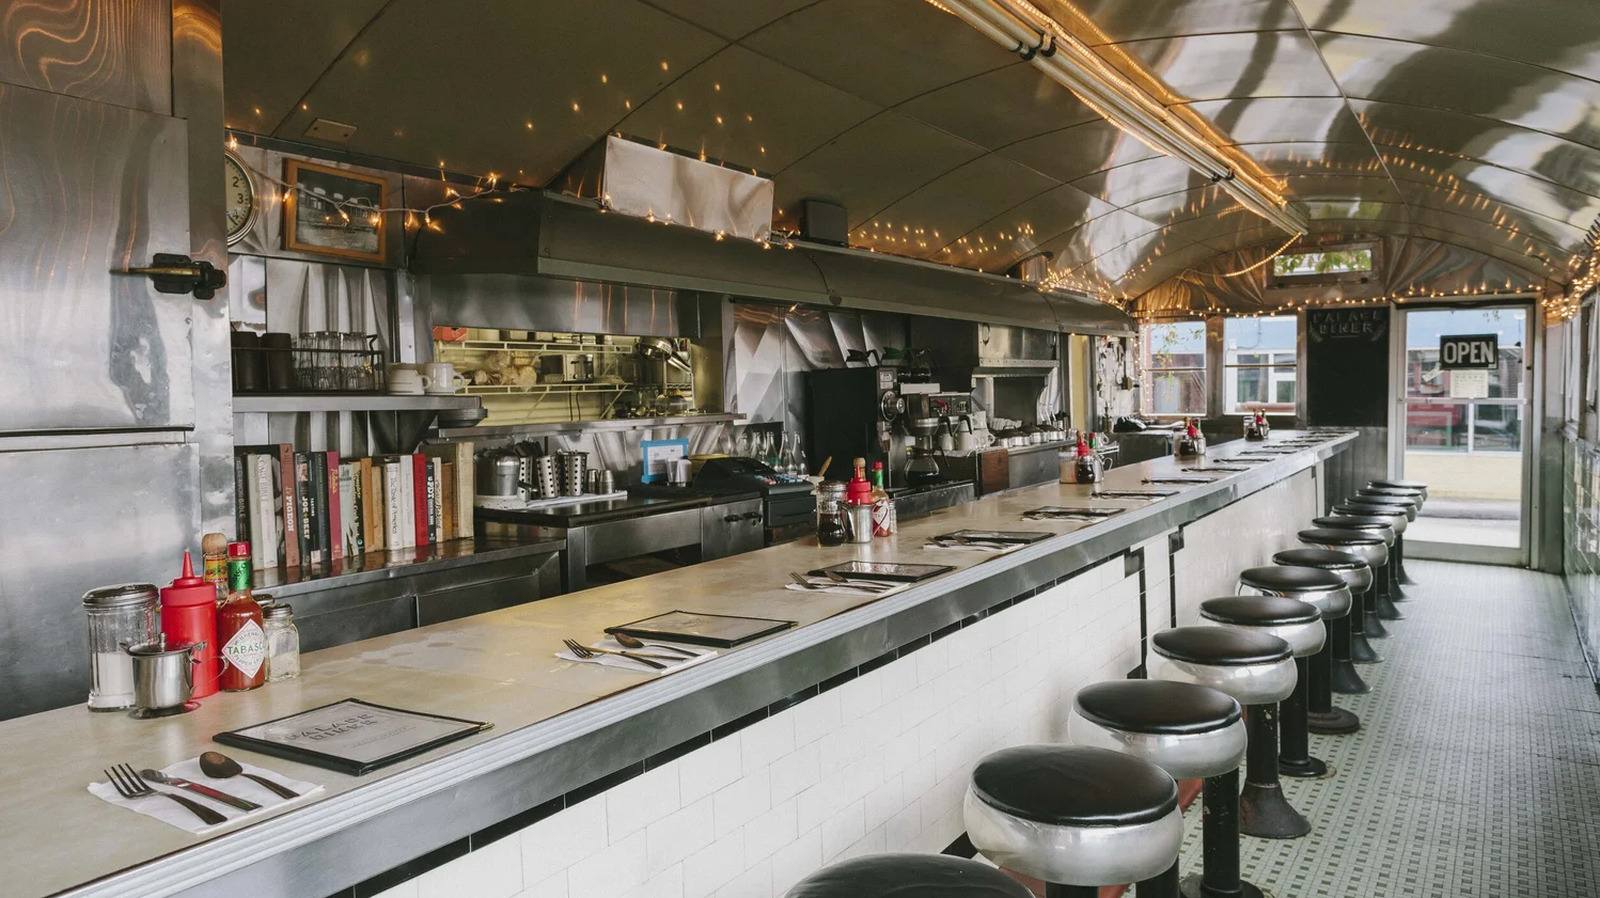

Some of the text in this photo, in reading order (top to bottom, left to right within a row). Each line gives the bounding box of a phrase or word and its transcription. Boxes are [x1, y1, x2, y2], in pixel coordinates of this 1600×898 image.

[232, 176, 239, 188] 2
[237, 193, 244, 204] 3
[1443, 341, 1494, 364] OPEN
[238, 498, 246, 518] BIBLE
[286, 495, 295, 532] PIGEON
[308, 719, 378, 741] DINER
